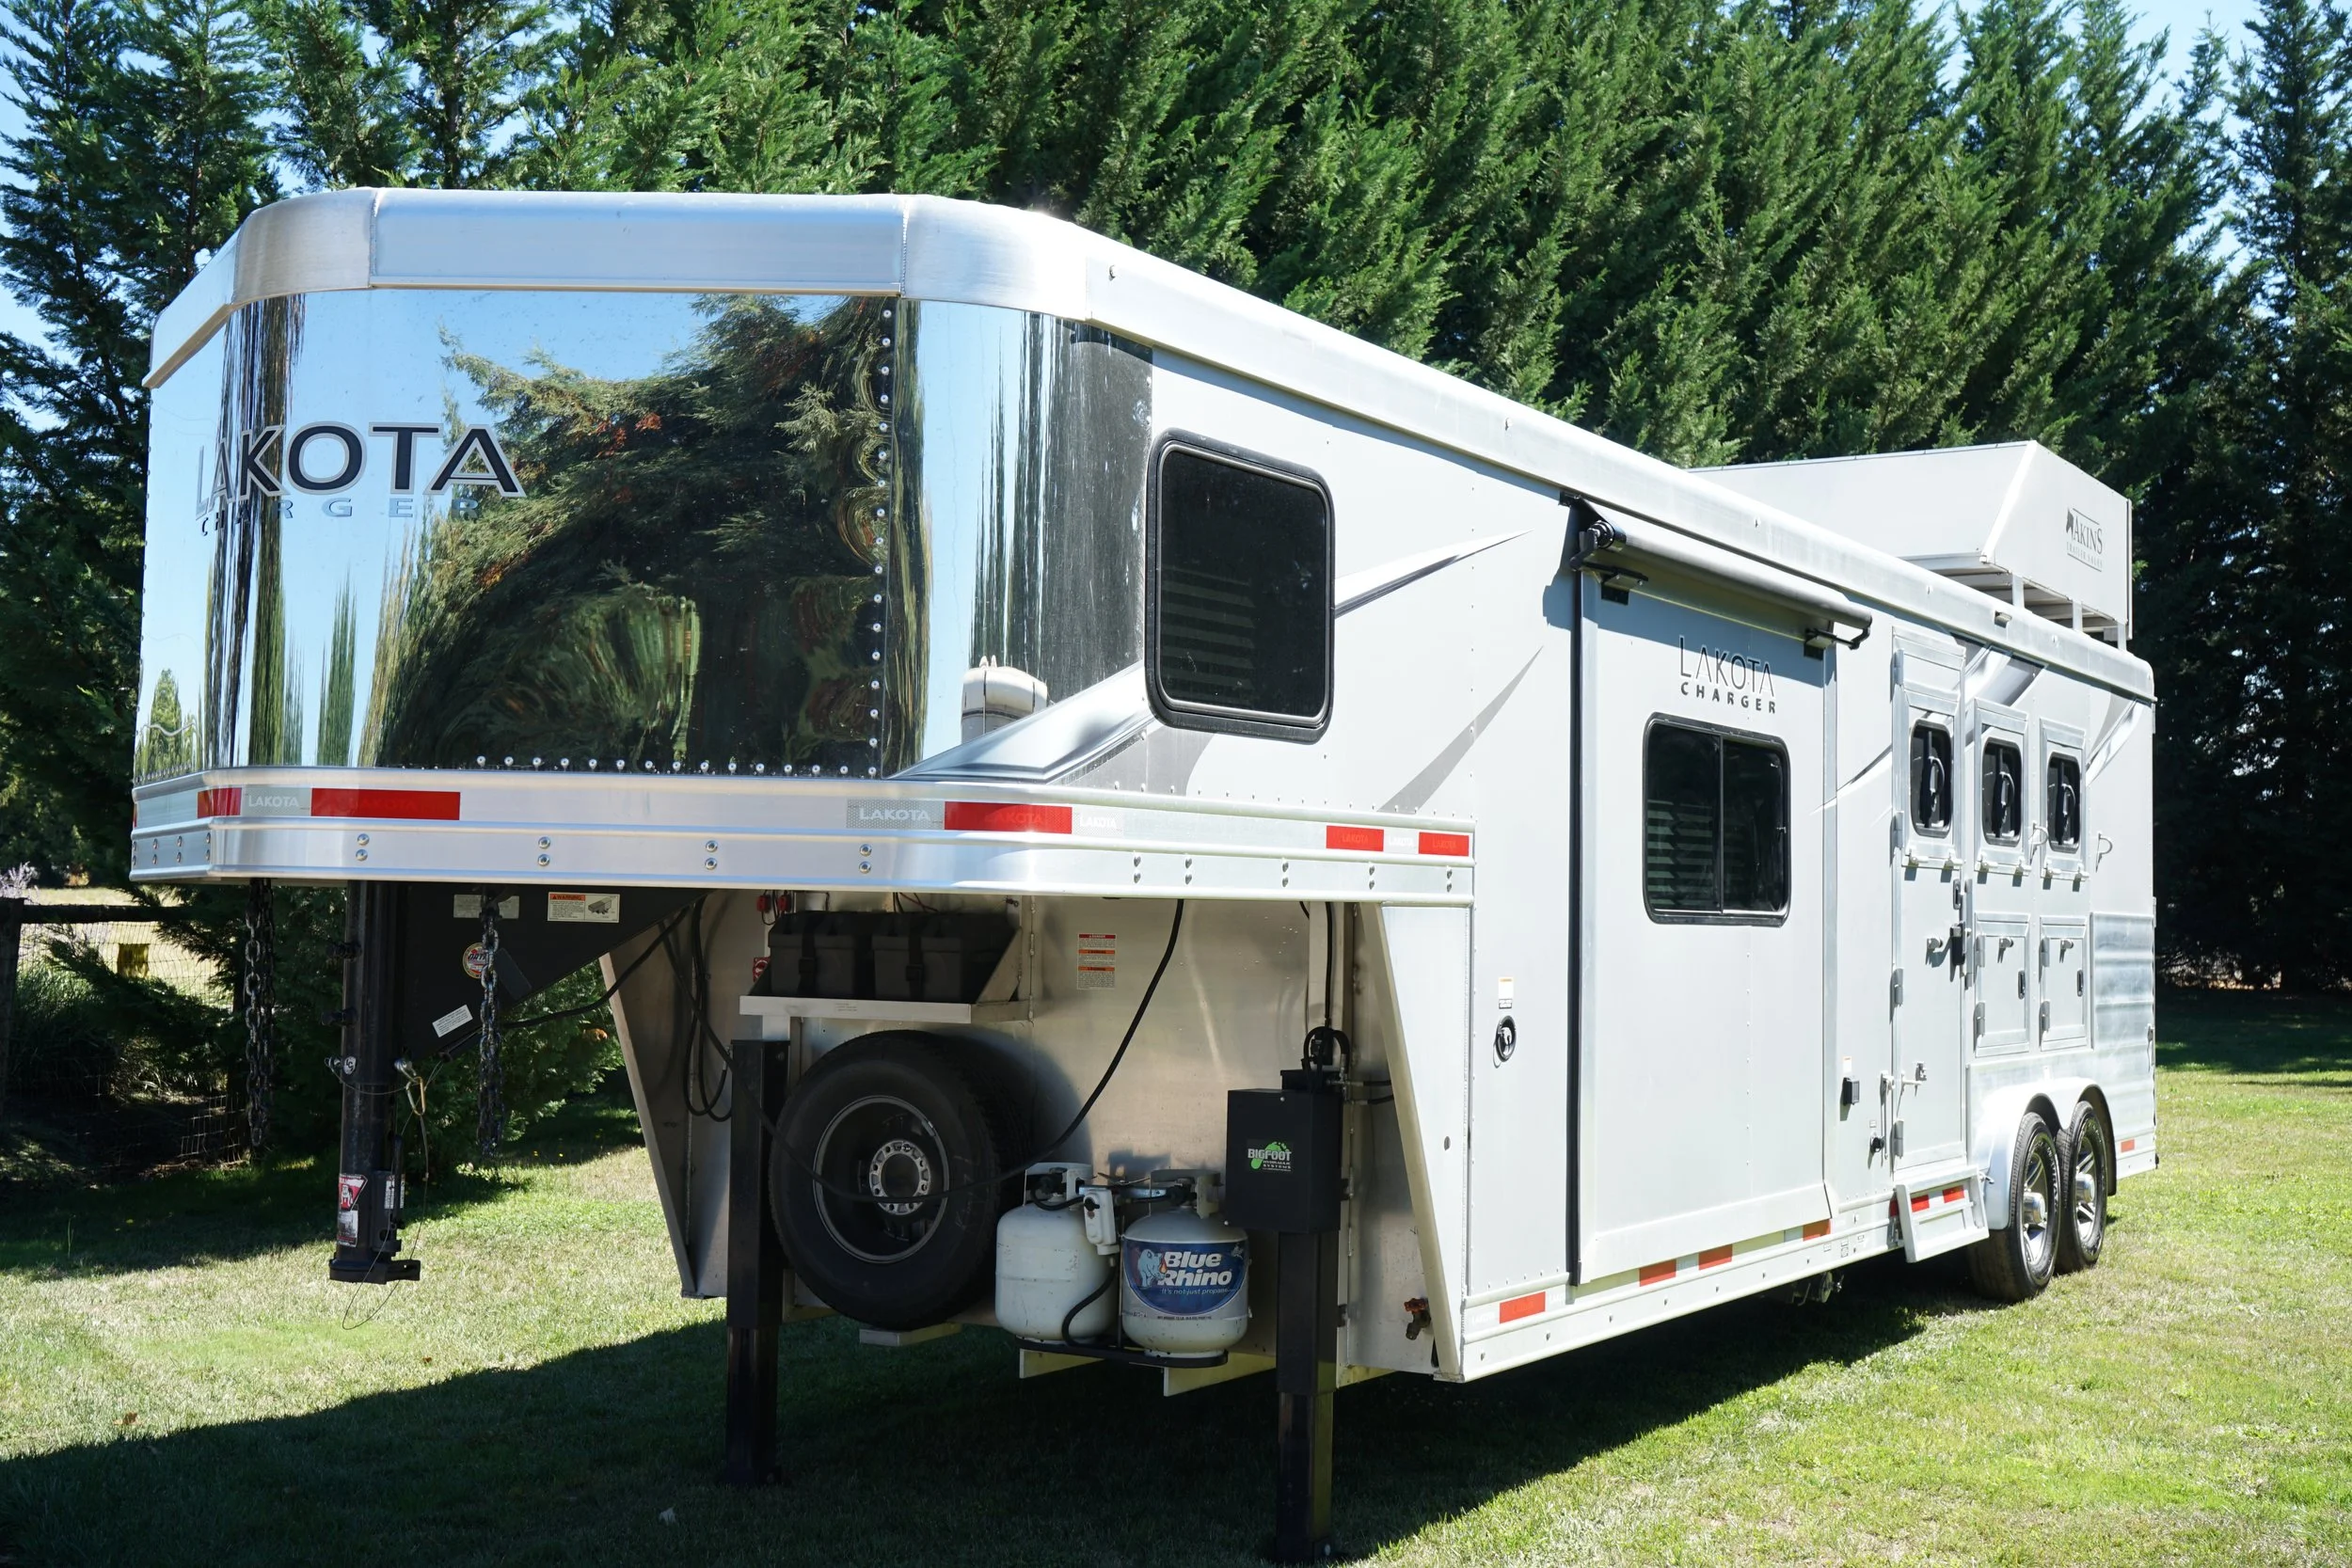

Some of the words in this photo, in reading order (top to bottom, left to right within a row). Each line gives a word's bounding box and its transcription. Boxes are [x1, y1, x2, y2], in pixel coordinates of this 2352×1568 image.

[196, 421, 527, 520] LAKOTA
[2074, 515, 2103, 554] AKINS
[1678, 635, 1775, 697] LAKOTA
[1680, 681, 1776, 714] CHARGER
[248, 795, 299, 807] LAKOTA
[859, 808, 931, 821] LAKOTA
[1248, 1148, 1292, 1161] BIGFOOT
[1164, 1251, 1222, 1268] Blue
[1157, 1269, 1232, 1287] Rhino
